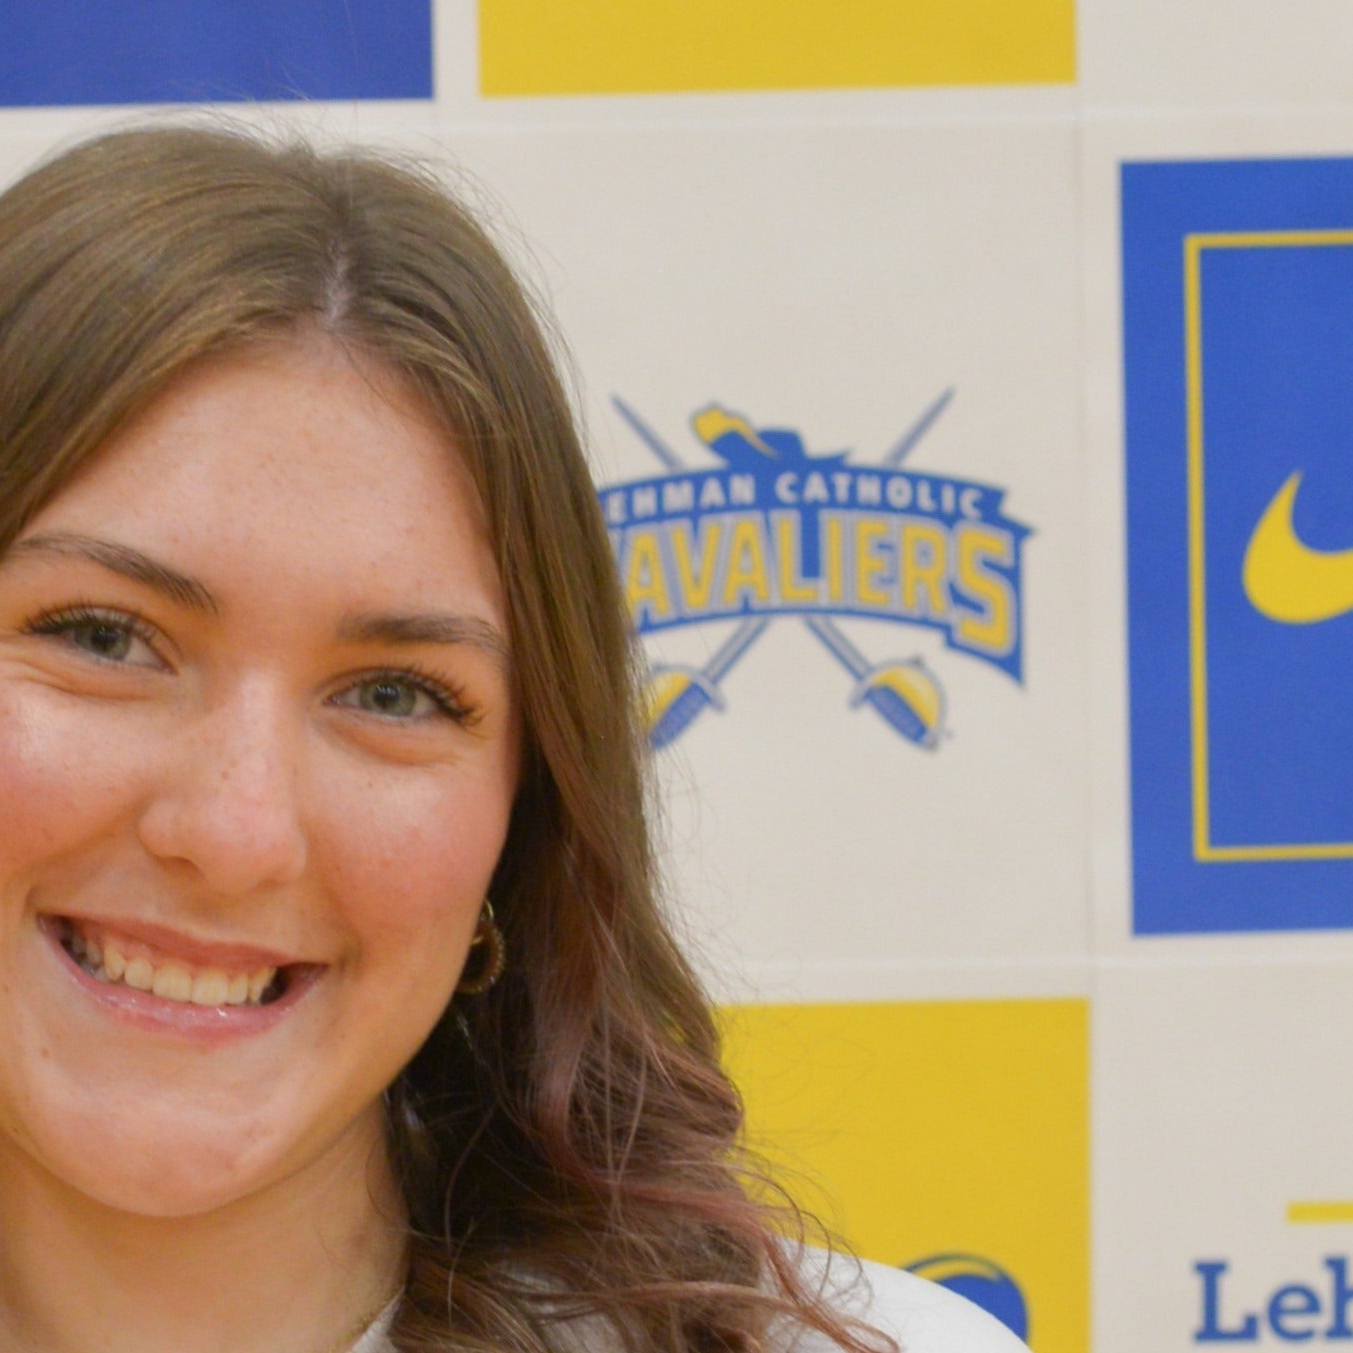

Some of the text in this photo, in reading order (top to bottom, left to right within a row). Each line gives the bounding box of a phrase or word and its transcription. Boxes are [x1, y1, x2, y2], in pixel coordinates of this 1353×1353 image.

[606, 472, 983, 523] EHMAN CATHOLIC
[613, 508, 1017, 661] AVALIERS
